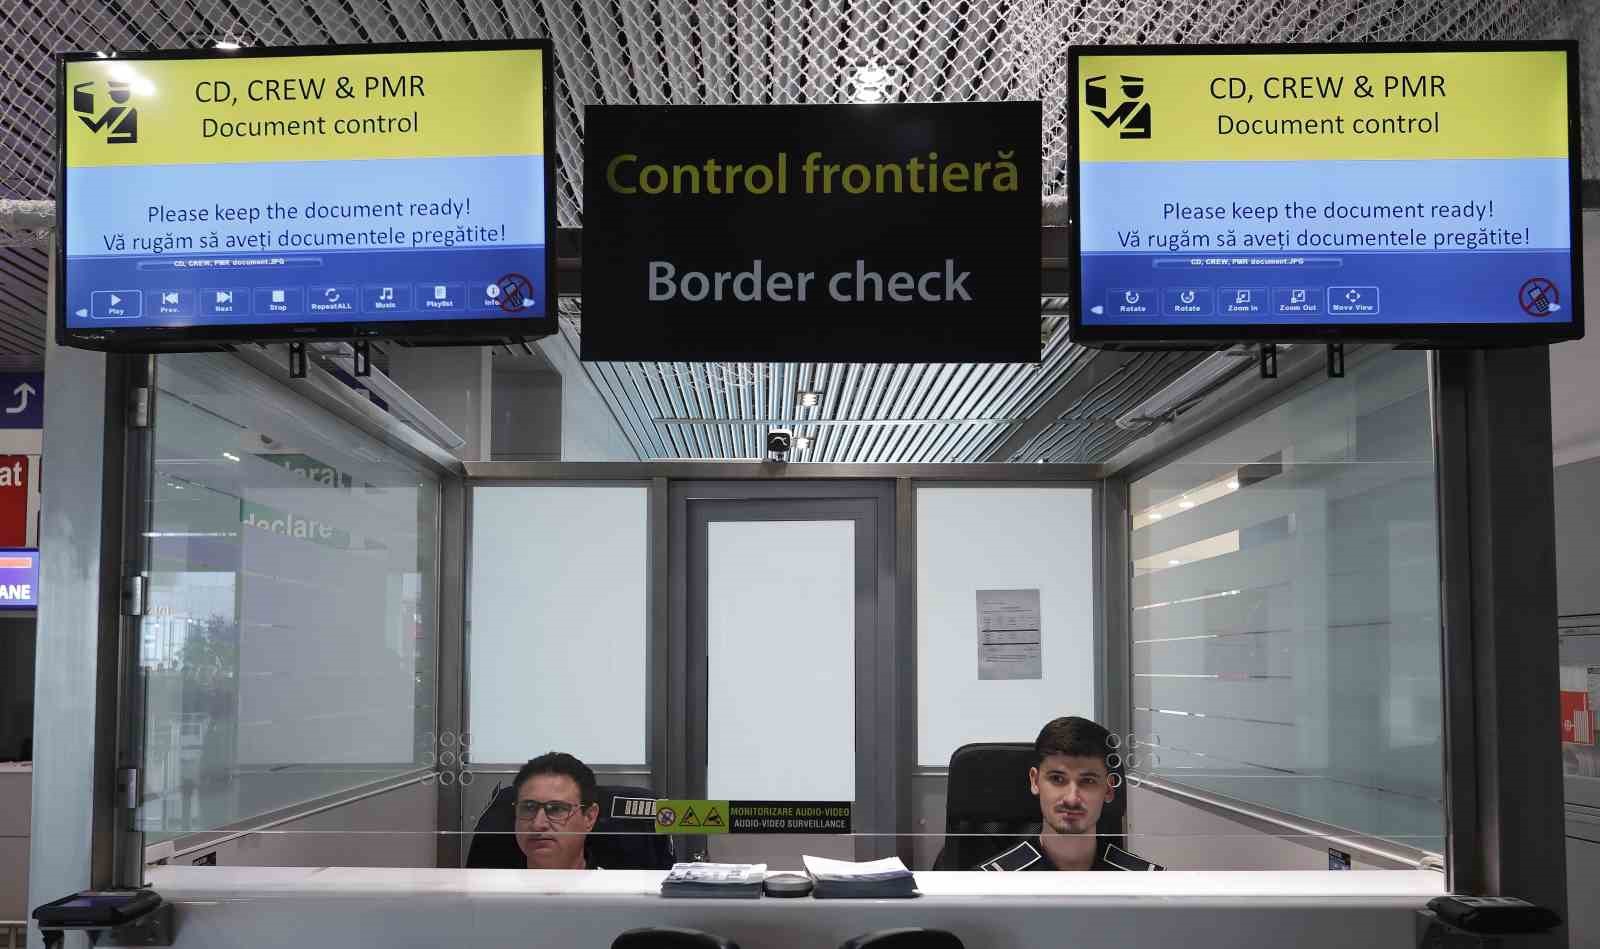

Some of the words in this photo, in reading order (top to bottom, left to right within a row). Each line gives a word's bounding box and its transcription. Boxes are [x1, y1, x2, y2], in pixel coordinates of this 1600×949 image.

[195, 81, 237, 106] CD,
[248, 78, 326, 101] CREW
[336, 76, 355, 99] &
[365, 75, 425, 98] PMR
[1210, 77, 1253, 103] CD,
[1264, 77, 1344, 99] CREW
[1353, 75, 1374, 98] &
[1385, 75, 1446, 98] PMR
[203, 116, 326, 138] Document
[334, 111, 418, 134] control
[1218, 115, 1345, 135] Document
[1353, 112, 1439, 134] control
[607, 152, 788, 195] Control
[802, 150, 1019, 194] frontieră
[148, 206, 209, 222] Please
[215, 204, 260, 224] keep
[267, 202, 298, 220] the
[305, 202, 404, 219] document
[410, 198, 471, 219] ready!
[1164, 203, 1225, 219] Please
[1232, 202, 1278, 222] keep
[1285, 201, 1317, 219] the
[1324, 202, 1424, 219] document
[1431, 200, 1493, 220] ready!
[103, 233, 125, 250] Vă
[133, 233, 193, 253] rugăm
[200, 232, 219, 248] să
[225, 231, 271, 250] aveți
[278, 227, 405, 247] documentele
[412, 224, 505, 247] pregătite!
[1118, 231, 1140, 247] Vă
[1148, 230, 1209, 251] rugăm
[1216, 229, 1236, 247] să
[1243, 230, 1290, 250] aveți
[1297, 229, 1426, 246] documentele
[1434, 228, 1529, 249] pregătite!
[648, 259, 814, 302] Border
[829, 259, 972, 302] check
[270, 304, 287, 312] Stop
[376, 301, 396, 309] Music
[426, 300, 453, 309] Playlist
[1120, 304, 1146, 312] Rotate
[1174, 304, 1201, 312] Rotate
[1228, 304, 1248, 312] Zoom
[1280, 304, 1300, 312] Zoom
[1302, 304, 1317, 312] Out
[1333, 304, 1352, 312] Move
[1354, 303, 1373, 312] View
[108, 308, 124, 316] Play
[730, 807, 793, 817] MONITORIZARE
[796, 807, 850, 817] AUDIO-VIDEO
[734, 818, 785, 828] AUDIO-VIDEO
[787, 818, 846, 828] SURVEILLANCE
